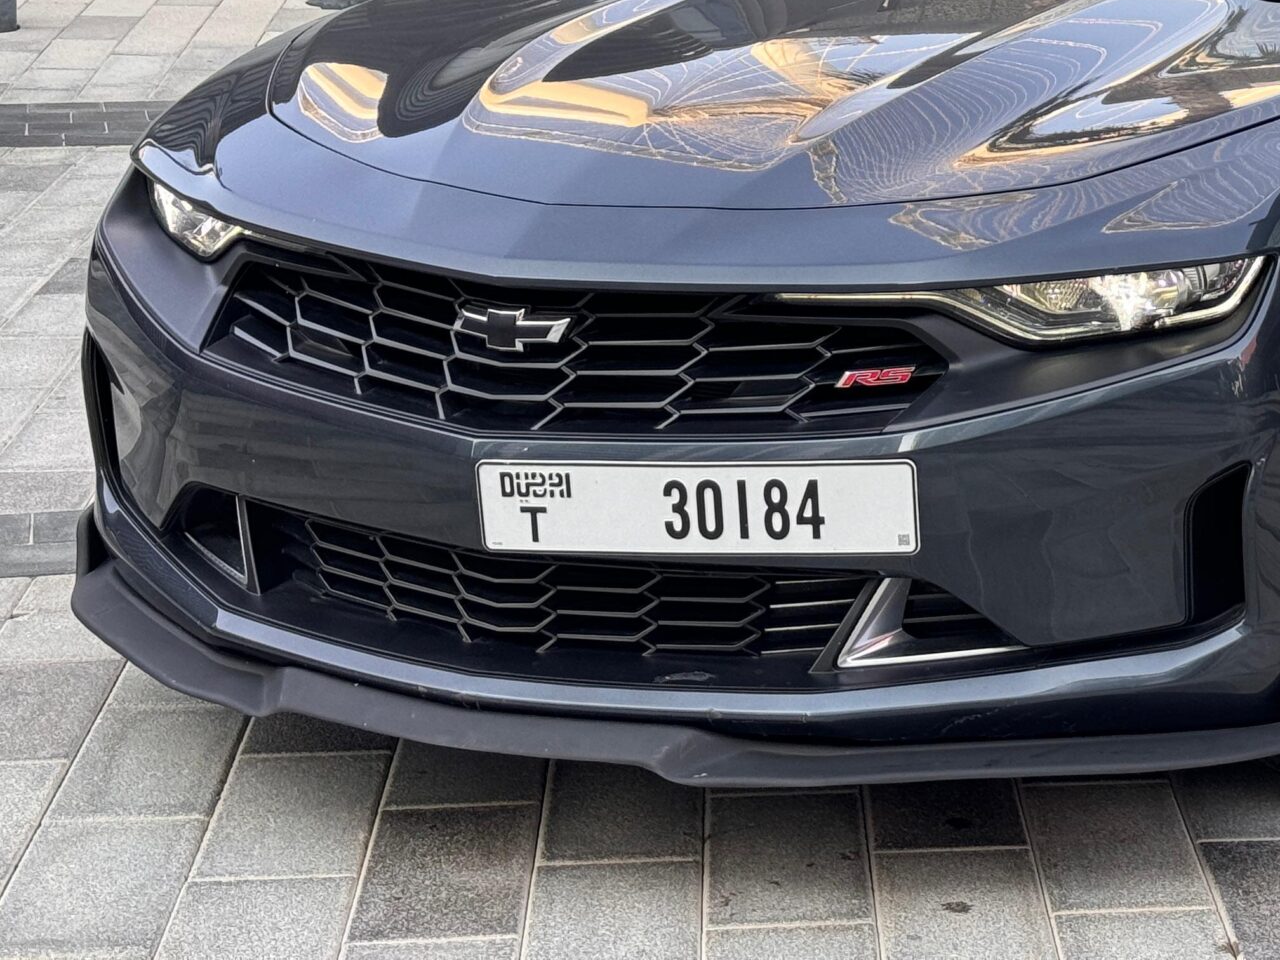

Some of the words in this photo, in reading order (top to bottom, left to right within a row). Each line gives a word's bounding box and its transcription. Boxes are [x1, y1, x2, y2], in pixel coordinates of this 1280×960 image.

[834, 365, 916, 388] RS
[520, 506, 547, 543] T
[662, 478, 826, 541] 30184
